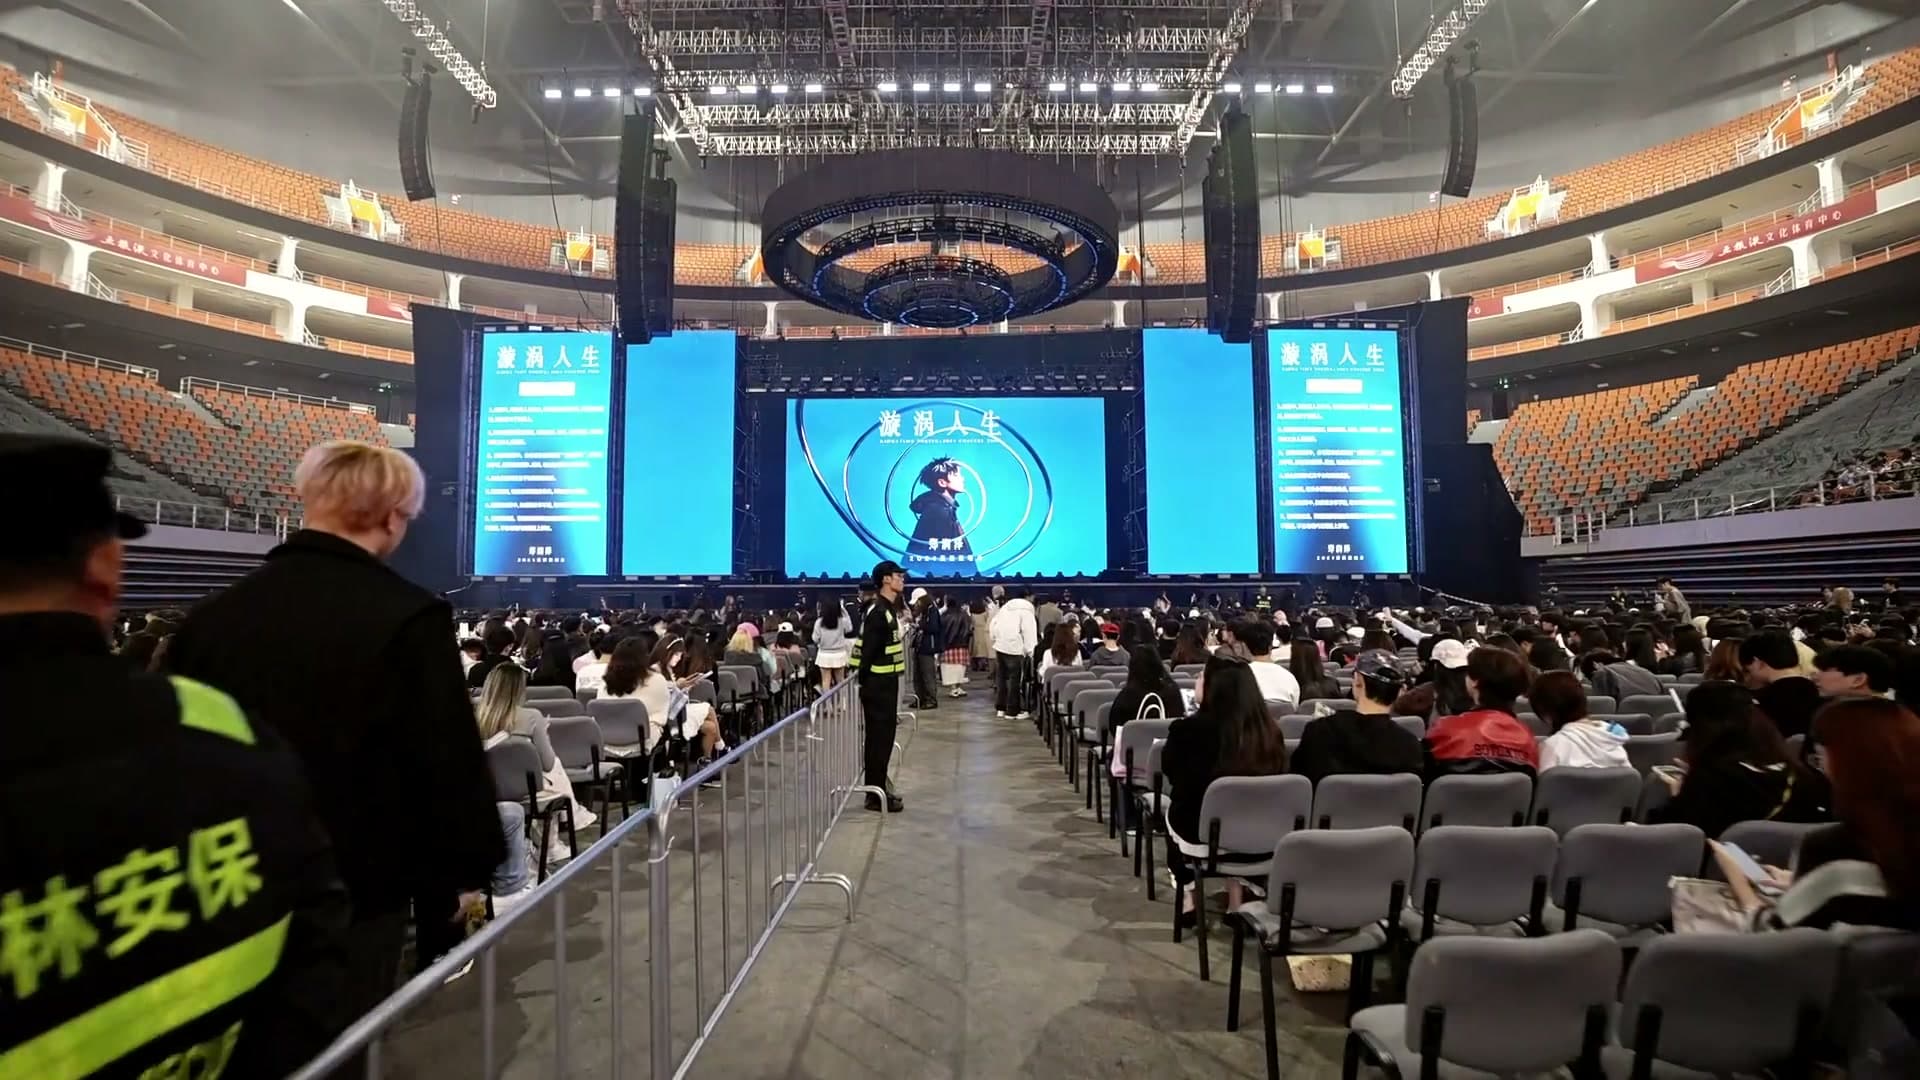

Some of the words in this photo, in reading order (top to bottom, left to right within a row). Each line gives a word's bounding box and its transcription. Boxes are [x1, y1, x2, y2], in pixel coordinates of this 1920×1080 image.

[879, 410, 1002, 437] 漩涡人生
[0, 817, 264, 998] 林安保
